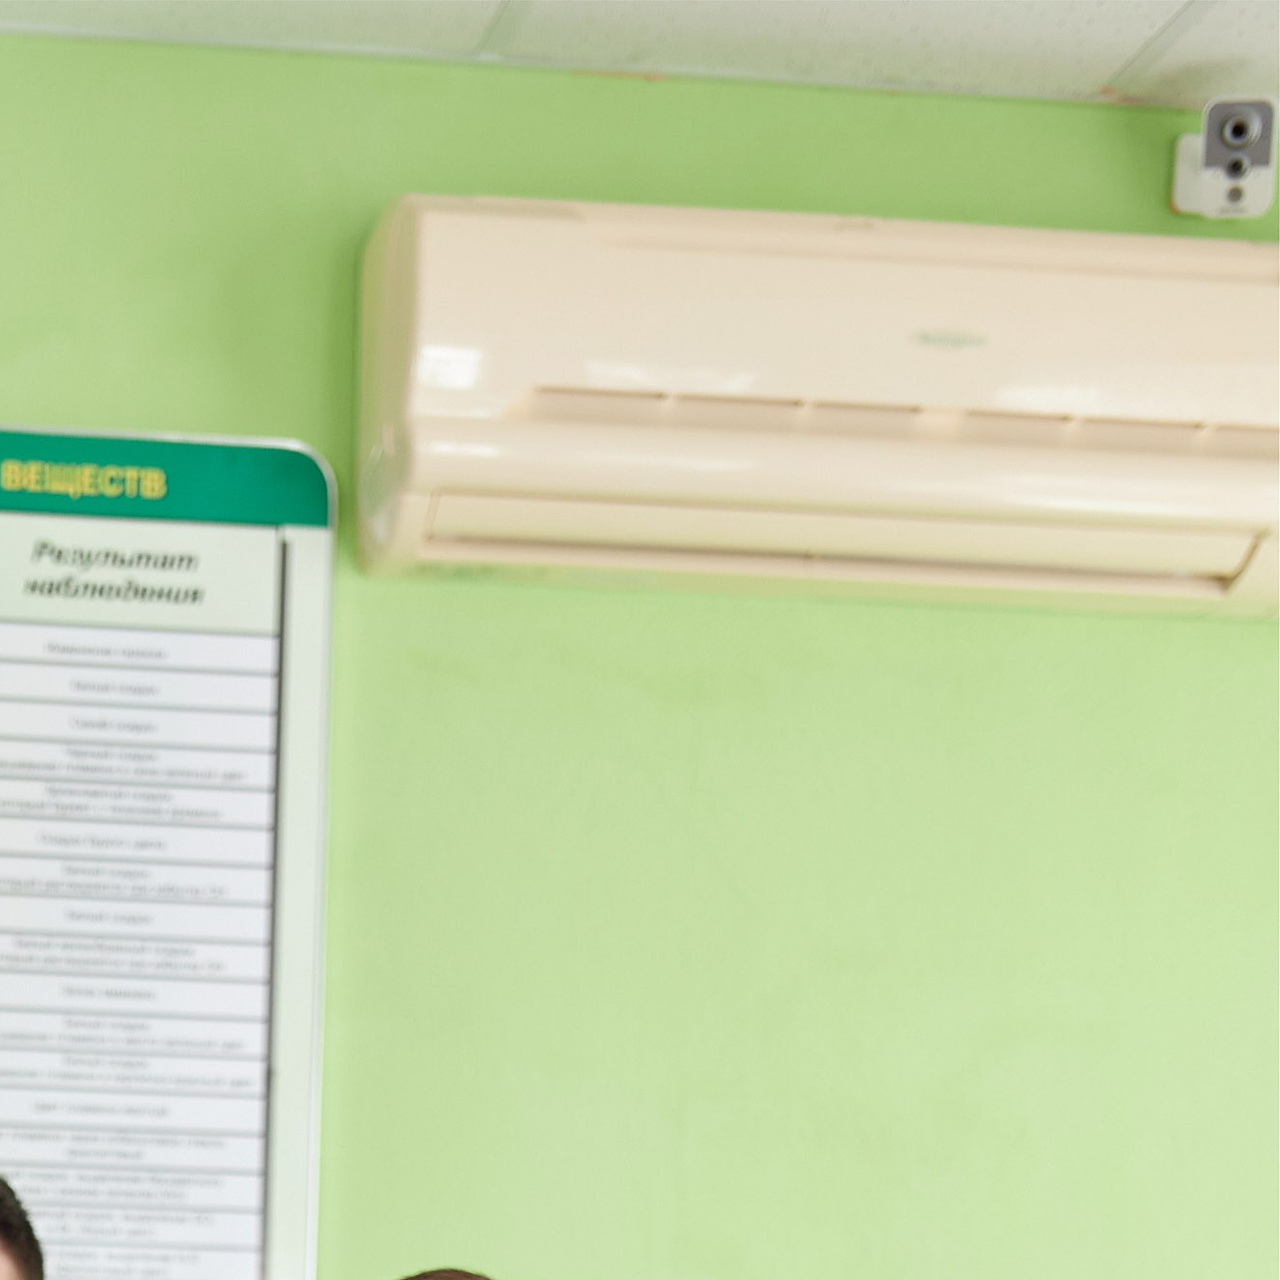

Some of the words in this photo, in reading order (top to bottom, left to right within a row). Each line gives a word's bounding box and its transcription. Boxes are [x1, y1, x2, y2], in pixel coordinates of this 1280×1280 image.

[0, 459, 167, 500] ВЕЩЕСТВ
[31, 538, 200, 572] Результат
[23, 574, 205, 606] наблюдения
